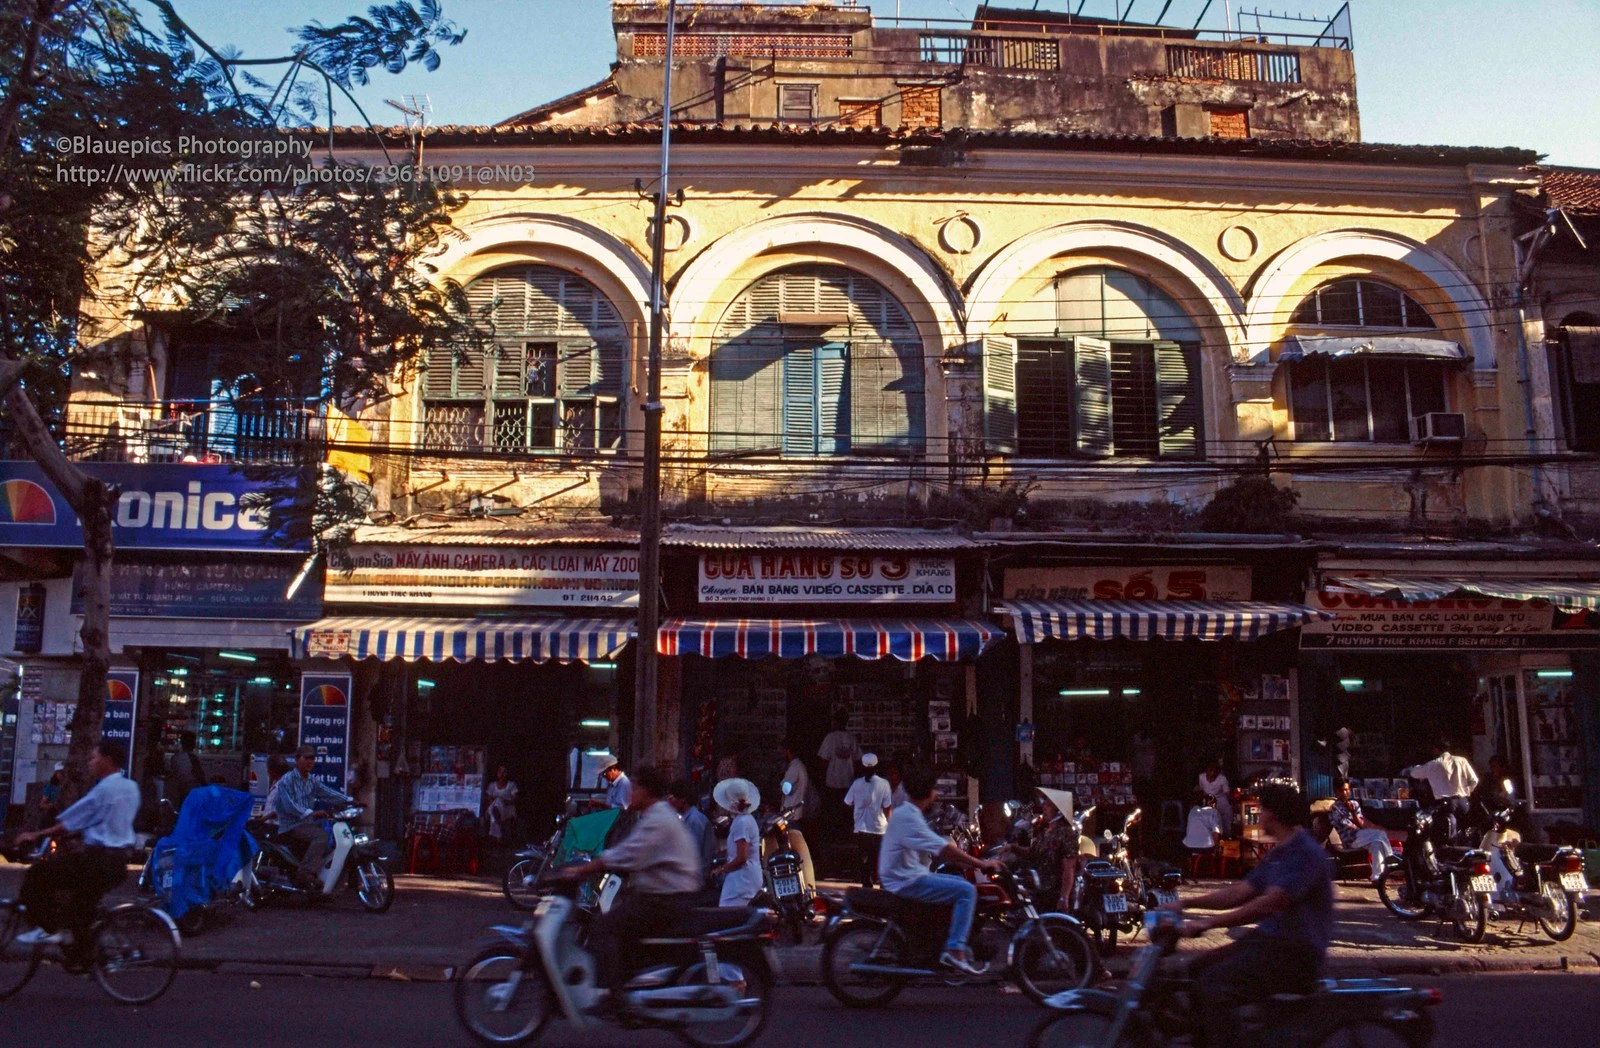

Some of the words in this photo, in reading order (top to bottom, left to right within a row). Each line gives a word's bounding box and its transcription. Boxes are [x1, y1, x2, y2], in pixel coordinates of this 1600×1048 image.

[76, 480, 275, 531] onica
[454, 554, 505, 571] CAMERA
[510, 558, 518, 570] &
[880, 553, 911, 581] 3
[847, 585, 905, 595] CASSETTE
[937, 585, 954, 595] CD
[1166, 571, 1207, 600] 5
[1360, 613, 1385, 622] MUA
[1331, 623, 1374, 632] VIDEO
[1381, 624, 1445, 632] CASSETTE
[1326, 635, 1335, 645] 7
